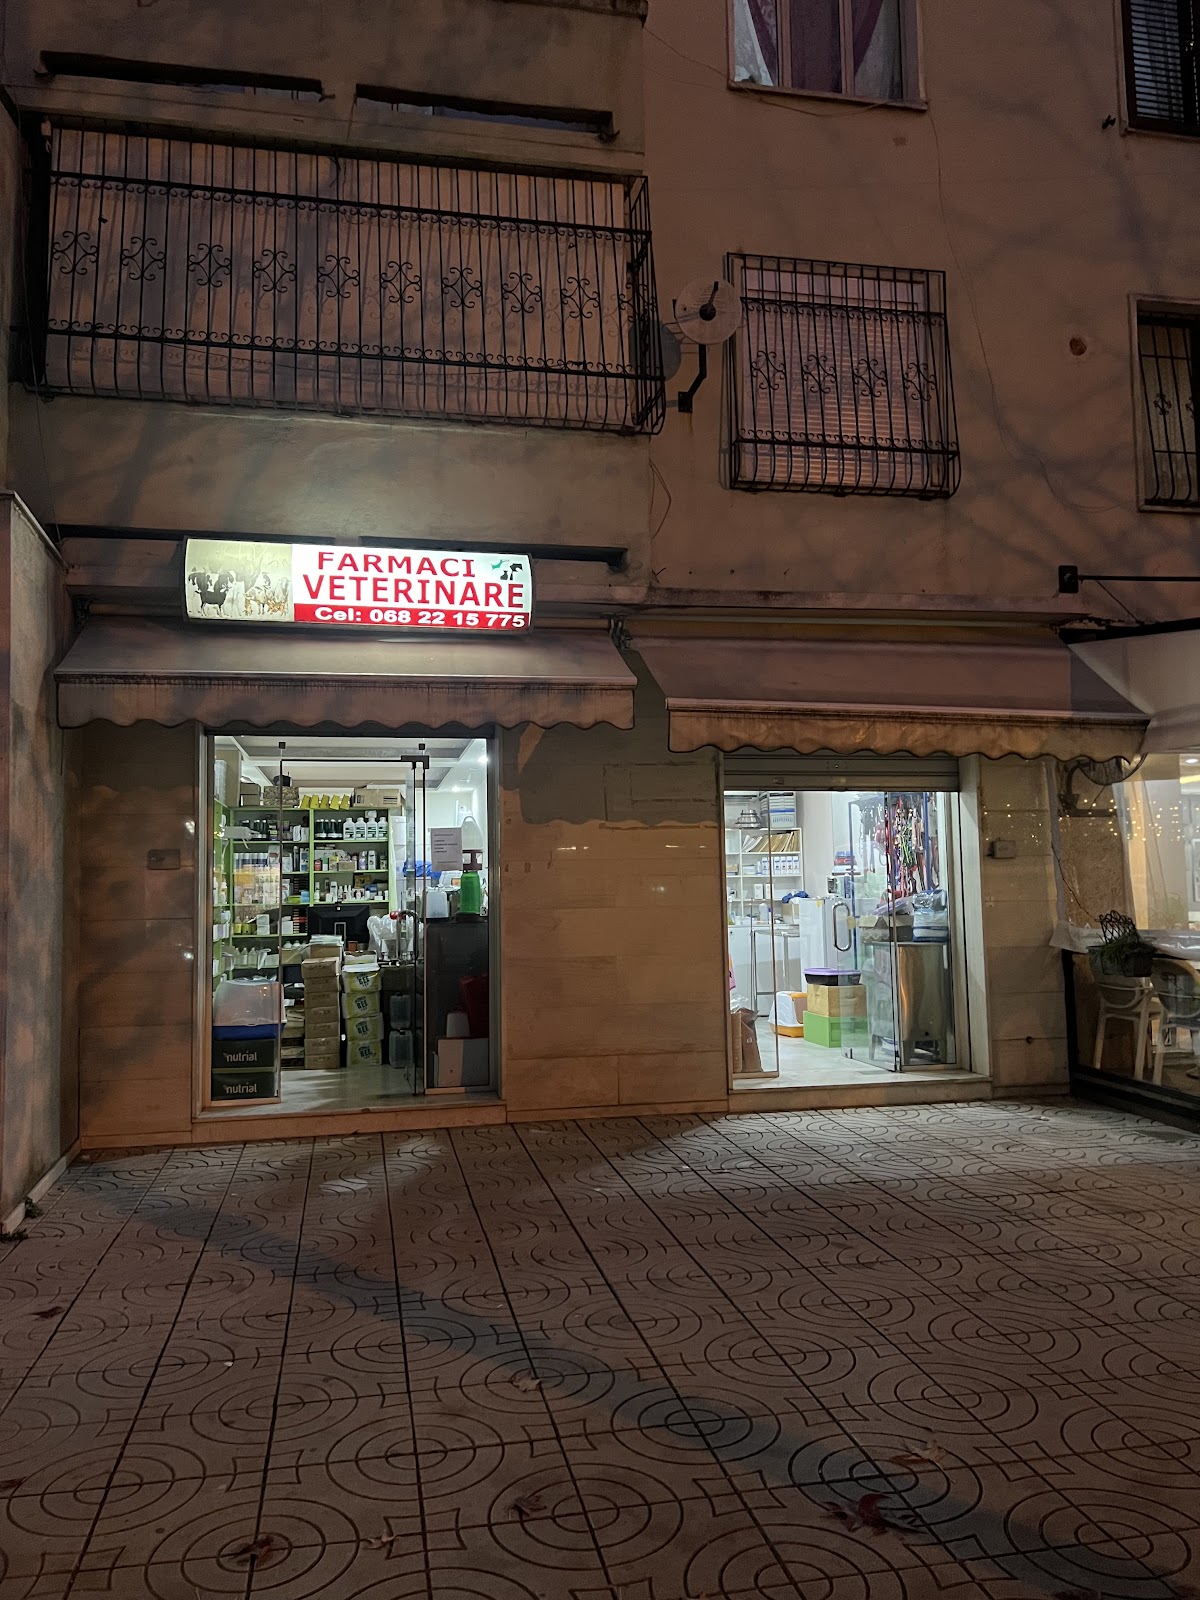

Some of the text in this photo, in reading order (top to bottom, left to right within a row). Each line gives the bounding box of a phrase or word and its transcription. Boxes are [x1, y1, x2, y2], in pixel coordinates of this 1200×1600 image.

[318, 552, 475, 577] FARMACI
[303, 574, 524, 608] VETERINARE
[315, 606, 525, 628] Cel: 068 22 15 775
[226, 1050, 258, 1062] nutrial
[226, 1082, 258, 1094] nutrial
